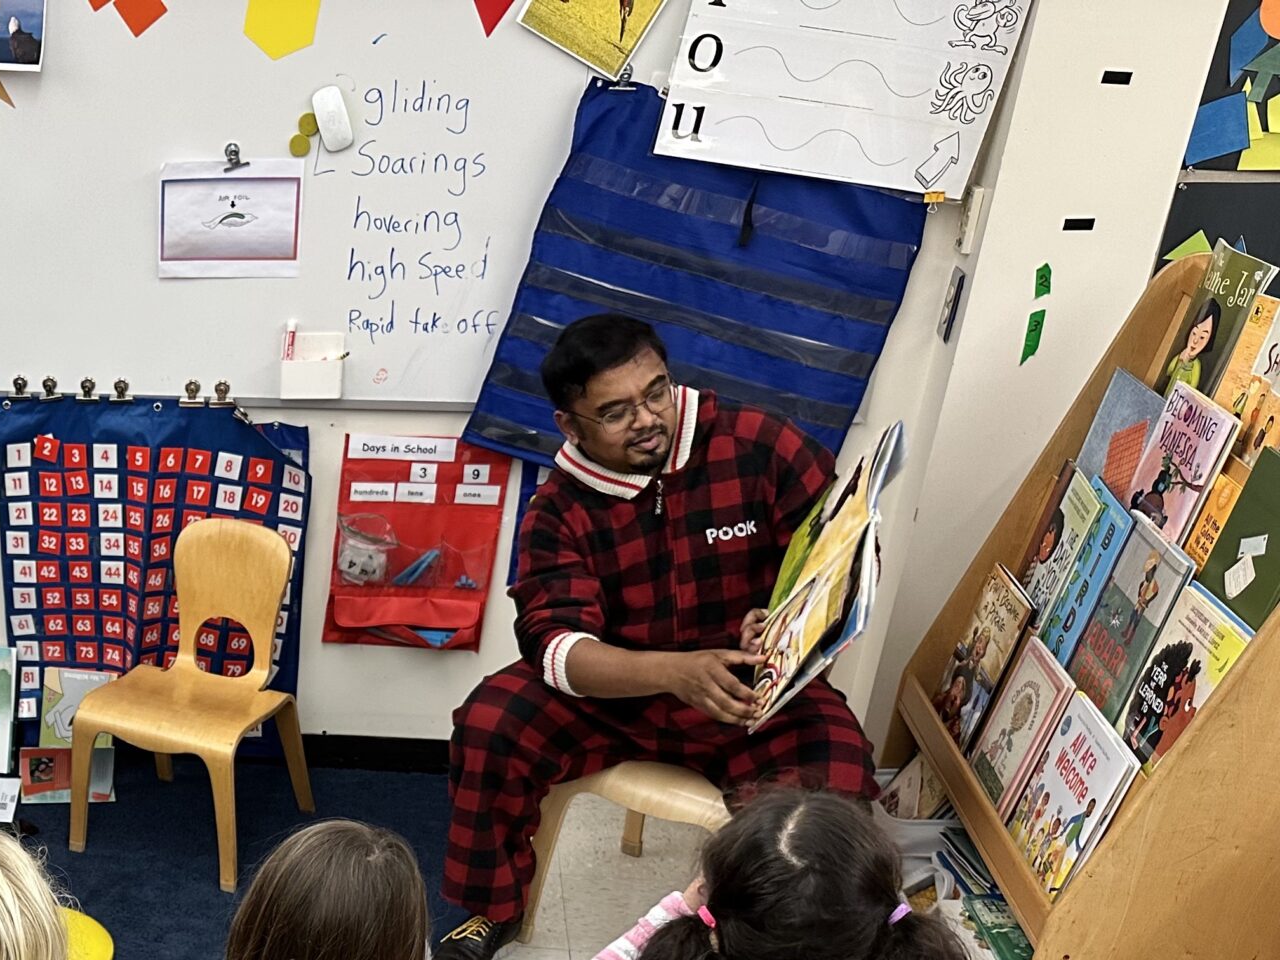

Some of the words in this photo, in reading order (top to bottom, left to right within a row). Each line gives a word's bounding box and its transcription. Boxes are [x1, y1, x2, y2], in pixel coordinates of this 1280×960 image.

[688, 33, 723, 73] o
[364, 79, 470, 134] gliding
[672, 103, 705, 142] u
[352, 140, 486, 196] Soarings
[354, 195, 462, 251] hovering
[348, 247, 406, 300] high
[1039, 274, 1050, 288] 2
[1226, 270, 1256, 307] Jar
[349, 300, 395, 344] Rapid
[457, 309, 499, 335] off
[1165, 389, 1218, 442] BECOMING
[362, 443, 386, 454] Days
[391, 444, 399, 453] in
[403, 445, 437, 455] School
[1159, 420, 1198, 471] VANESSA
[16, 449, 21, 461] 1
[42, 442, 52, 455] 2
[72, 449, 80, 462] 3
[101, 450, 109, 462] 4
[135, 452, 143, 465] 5
[167, 453, 175, 467] 6
[194, 455, 203, 468] 7
[224, 459, 233, 472] 8
[256, 464, 265, 477] 9
[288, 471, 300, 485] 10
[419, 467, 427, 479] 3
[471, 469, 480, 480] 9
[11, 478, 22, 490] 11
[44, 478, 57, 492] 12
[70, 476, 84, 489] 13
[99, 480, 112, 492] 14
[132, 482, 144, 496] 15
[159, 484, 170, 498] 16
[192, 486, 205, 500] 17
[222, 491, 235, 504] 18
[251, 493, 265, 507] 19
[282, 500, 298, 513] 20
[15, 508, 27, 520] 21
[43, 508, 58, 521] 22
[71, 509, 86, 521] 23
[102, 510, 118, 521] 24
[129, 511, 141, 526] 25
[156, 514, 169, 527] 26
[706, 520, 757, 544] POOK
[12, 537, 24, 548] 31
[41, 535, 57, 549] 32
[69, 538, 84, 550] 33
[104, 538, 120, 550] 34
[128, 540, 139, 555] 35
[153, 543, 166, 556] 36
[1200, 524, 1215, 545] Colors
[20, 566, 32, 578] 41
[40, 566, 56, 578] 42
[72, 566, 88, 578] 43
[105, 567, 120, 578] 44
[128, 569, 138, 584] 45
[149, 574, 162, 586] 46
[20, 593, 31, 603] 51
[46, 592, 61, 604] 52
[75, 593, 90, 605] 53
[102, 594, 118, 606] 54
[147, 602, 159, 614] 56
[18, 619, 29, 630] 61
[48, 619, 63, 631] 62
[76, 619, 91, 631] 63
[105, 622, 120, 634] 64
[145, 629, 158, 642] 66
[200, 633, 214, 646] 68
[231, 637, 246, 650] 69
[22, 645, 33, 656] 71
[47, 645, 61, 657] 72
[80, 646, 94, 658] 73
[106, 648, 119, 662] 74
[227, 665, 242, 676] 79
[1151, 664, 1168, 688] YEAR
[23, 671, 34, 683] 81
[1139, 681, 1164, 713] LEARNED
[1070, 731, 1087, 758] All
[1079, 744, 1098, 775] Are
